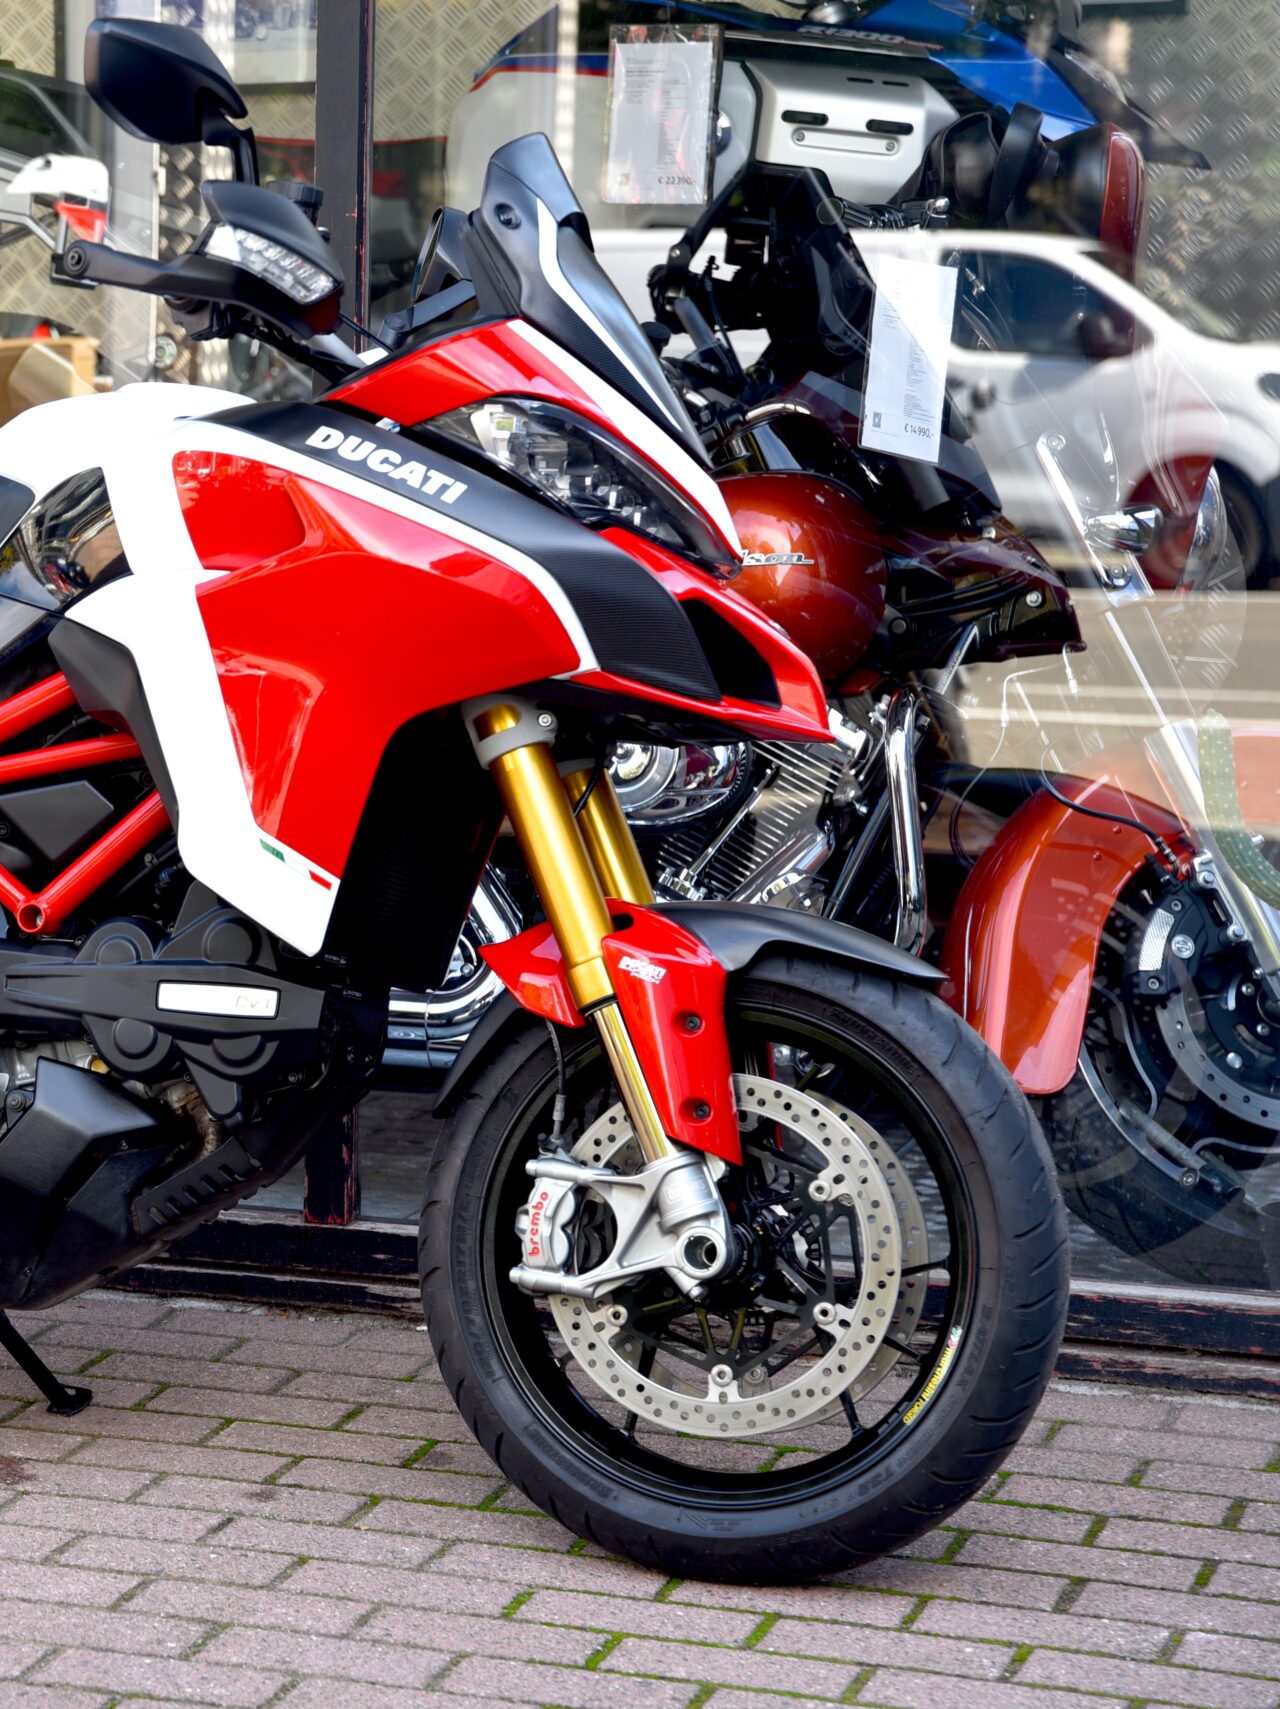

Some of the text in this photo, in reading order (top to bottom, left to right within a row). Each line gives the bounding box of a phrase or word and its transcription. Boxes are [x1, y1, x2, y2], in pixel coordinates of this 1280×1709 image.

[305, 425, 468, 504] DUCATI
[618, 955, 667, 980] DUCATI
[528, 1191, 549, 1256] brembo
